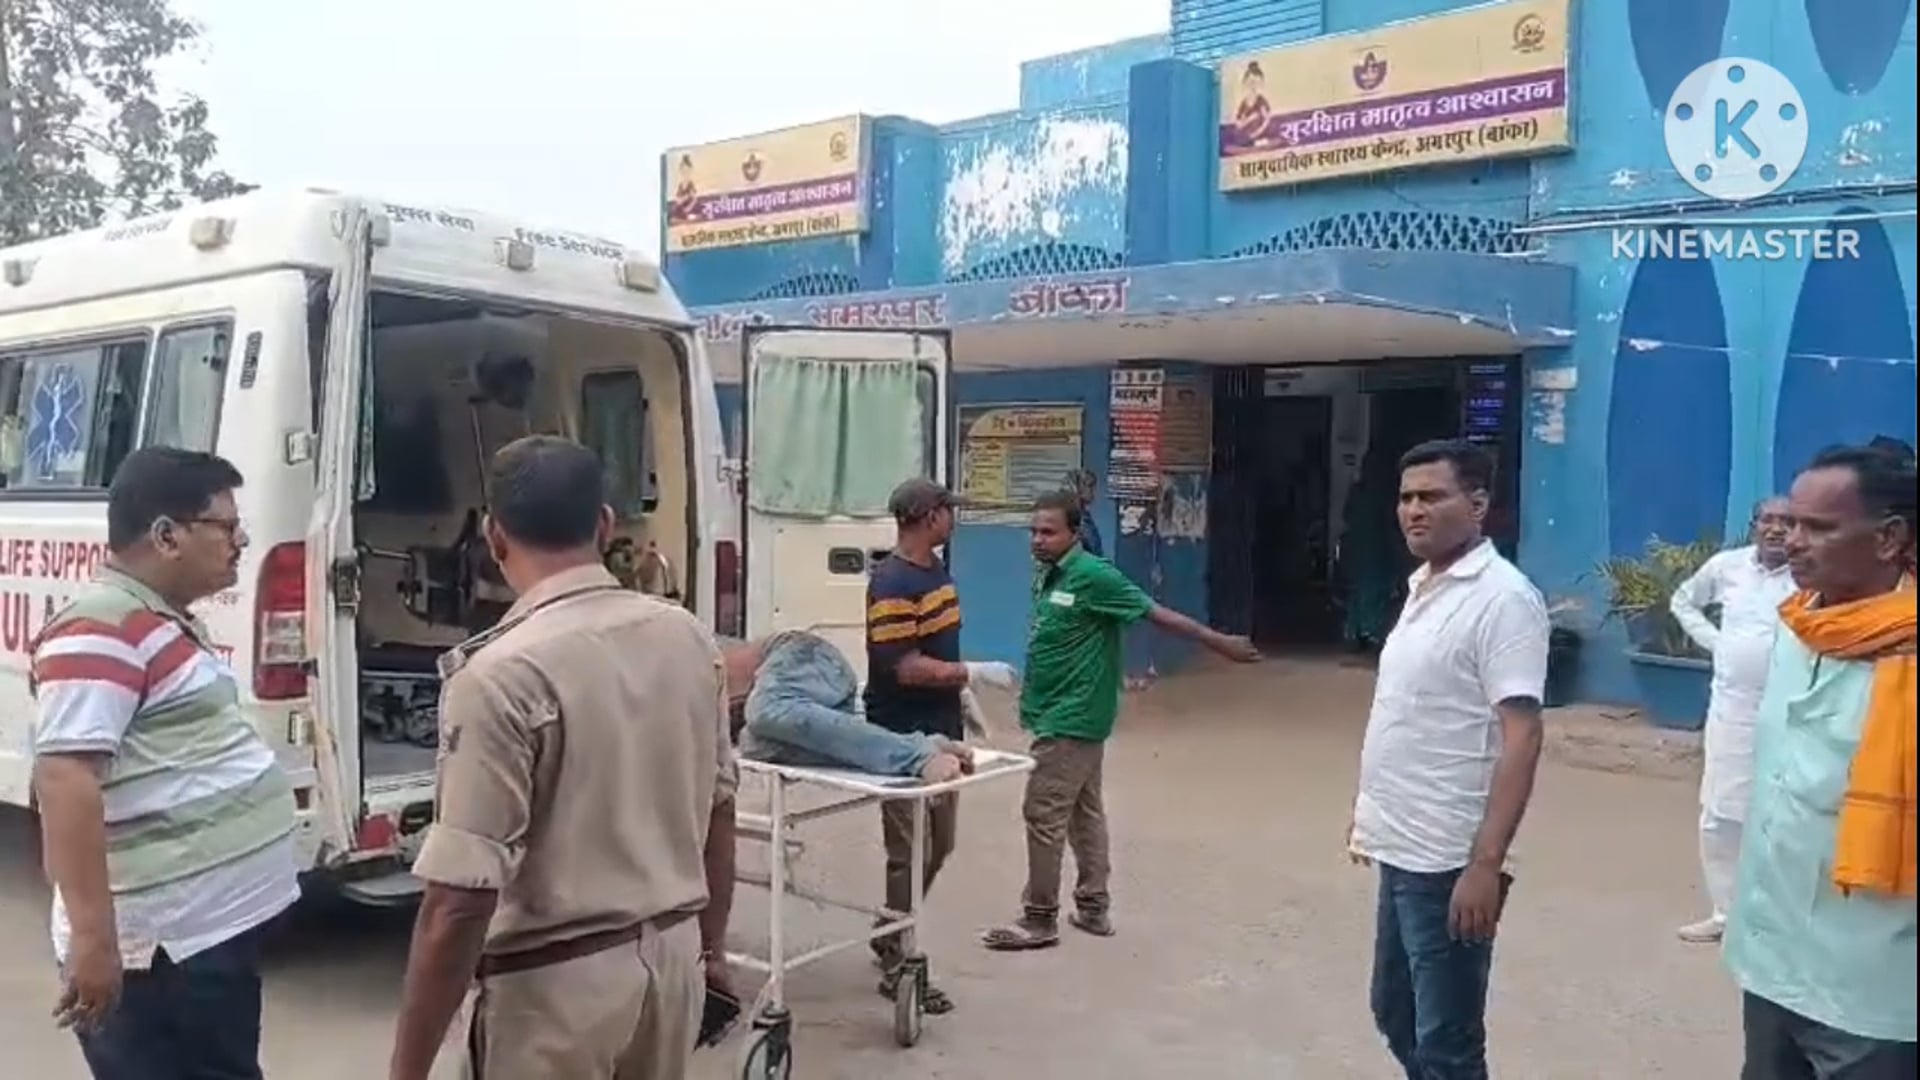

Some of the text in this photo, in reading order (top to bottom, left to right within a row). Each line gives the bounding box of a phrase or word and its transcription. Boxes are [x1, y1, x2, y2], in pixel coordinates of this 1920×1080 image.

[1280, 79, 1556, 145] सुरक्षित मातृत्व आश्वासन
[1239, 152, 1313, 180] सामुदायिक
[1416, 129, 1474, 155] अमरपुर
[1478, 117, 1539, 147] (बांका)
[515, 227, 624, 261] Free Service
[0, 539, 34, 577] LIFE
